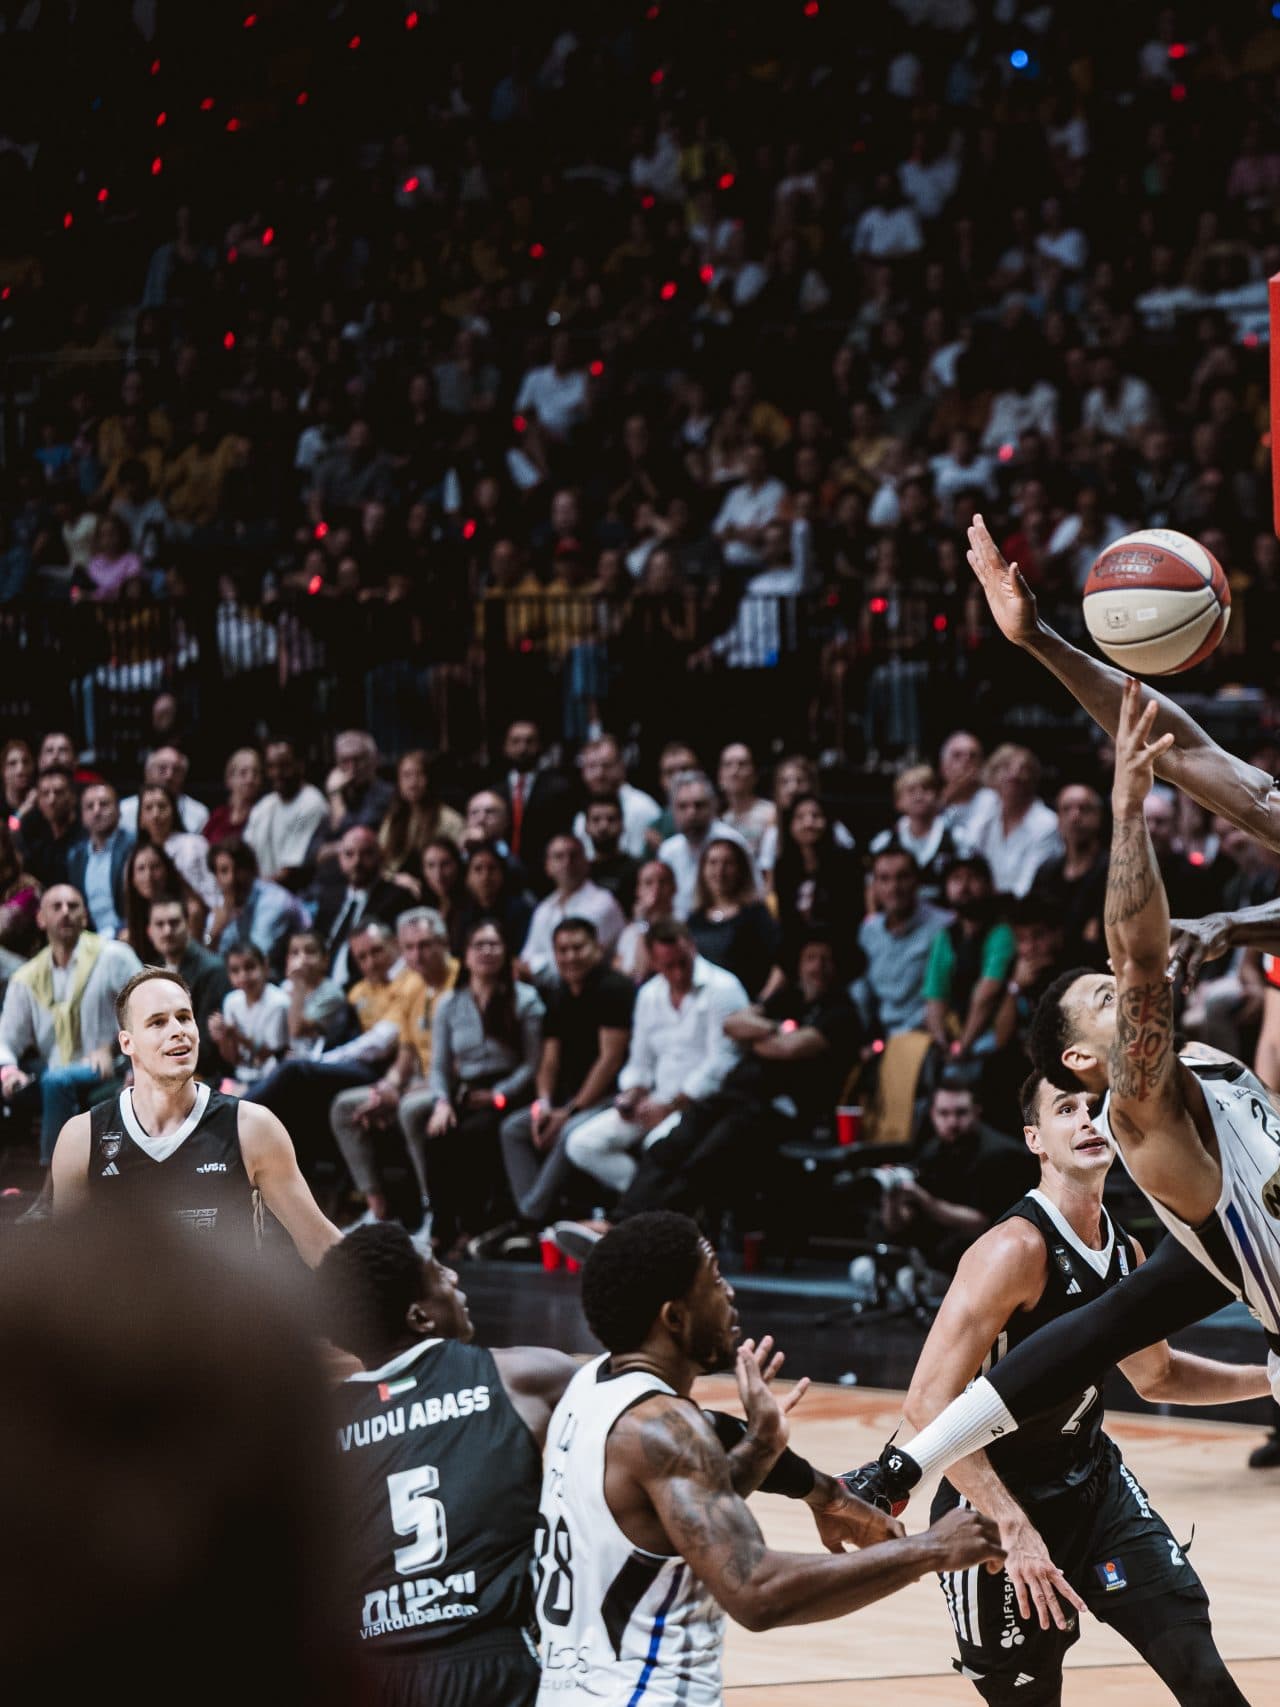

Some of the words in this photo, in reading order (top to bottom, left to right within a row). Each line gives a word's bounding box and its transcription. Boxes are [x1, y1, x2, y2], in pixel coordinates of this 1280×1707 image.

[408, 1385, 491, 1431] ABASS
[387, 1464, 448, 1576] 5
[1166, 1539, 1185, 1566] 2
